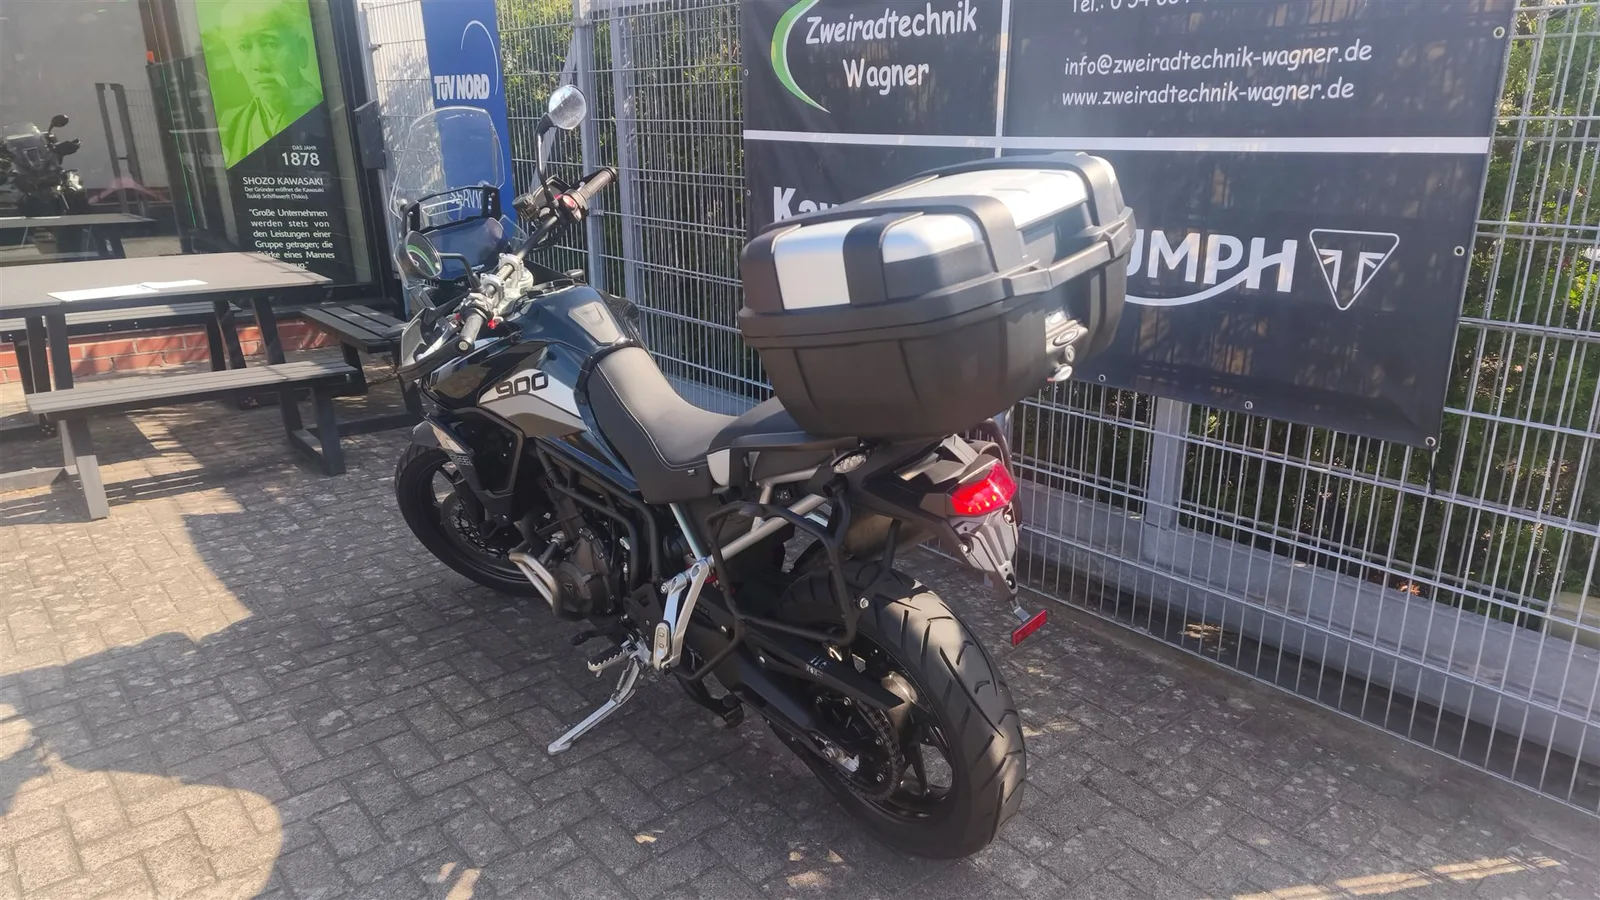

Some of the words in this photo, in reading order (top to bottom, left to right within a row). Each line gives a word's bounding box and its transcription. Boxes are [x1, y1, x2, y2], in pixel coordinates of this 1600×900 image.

[805, 1, 978, 45] Zweiradtechnik
[1064, 38, 1373, 76] info@zweiradtechnik-wagner.de
[842, 57, 929, 96] Wagner
[456, 73, 490, 100] NORD
[1062, 76, 1355, 107] www.zweiradtechnik-wagner.de
[282, 152, 320, 166] 1878
[243, 176, 275, 185] SHOZO
[277, 177, 324, 186] KAWASAKI
[277, 209, 328, 217] Unternehmen
[251, 220, 283, 228] werden
[288, 220, 308, 228] stets
[253, 230, 267, 238] den
[270, 230, 310, 239] Leistungen
[255, 240, 284, 249] Gruppe
[285, 241, 320, 250] getragen;
[321, 241, 334, 249] die
[283, 251, 302, 259] eines
[305, 251, 335, 259] Mannes
[495, 371, 549, 400] 900
